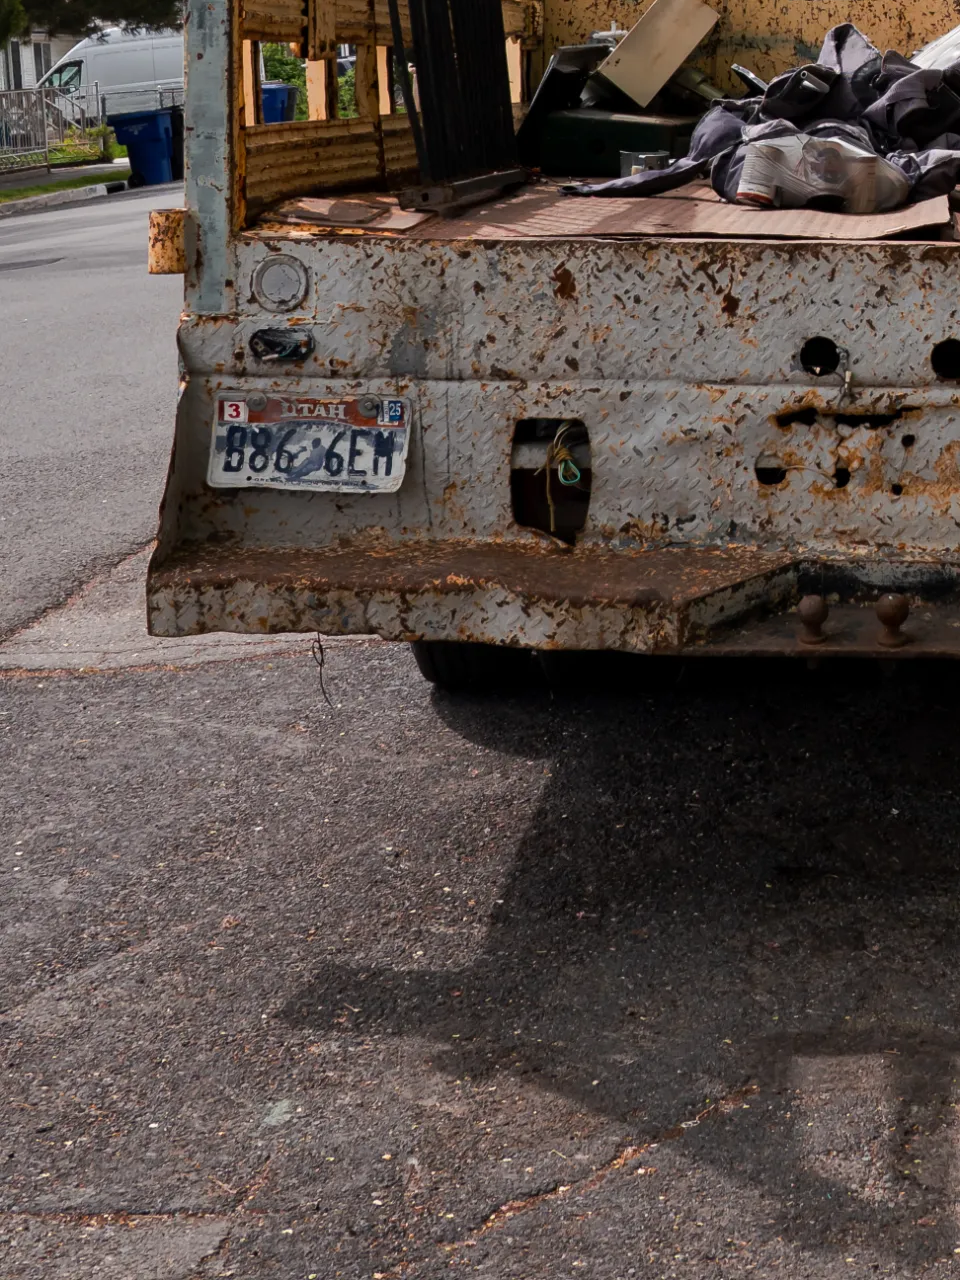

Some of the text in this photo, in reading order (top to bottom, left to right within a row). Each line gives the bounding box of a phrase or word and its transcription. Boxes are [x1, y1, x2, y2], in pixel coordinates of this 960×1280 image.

[227, 403, 242, 419] 3
[280, 401, 347, 420] UTAH
[389, 403, 402, 416] 25
